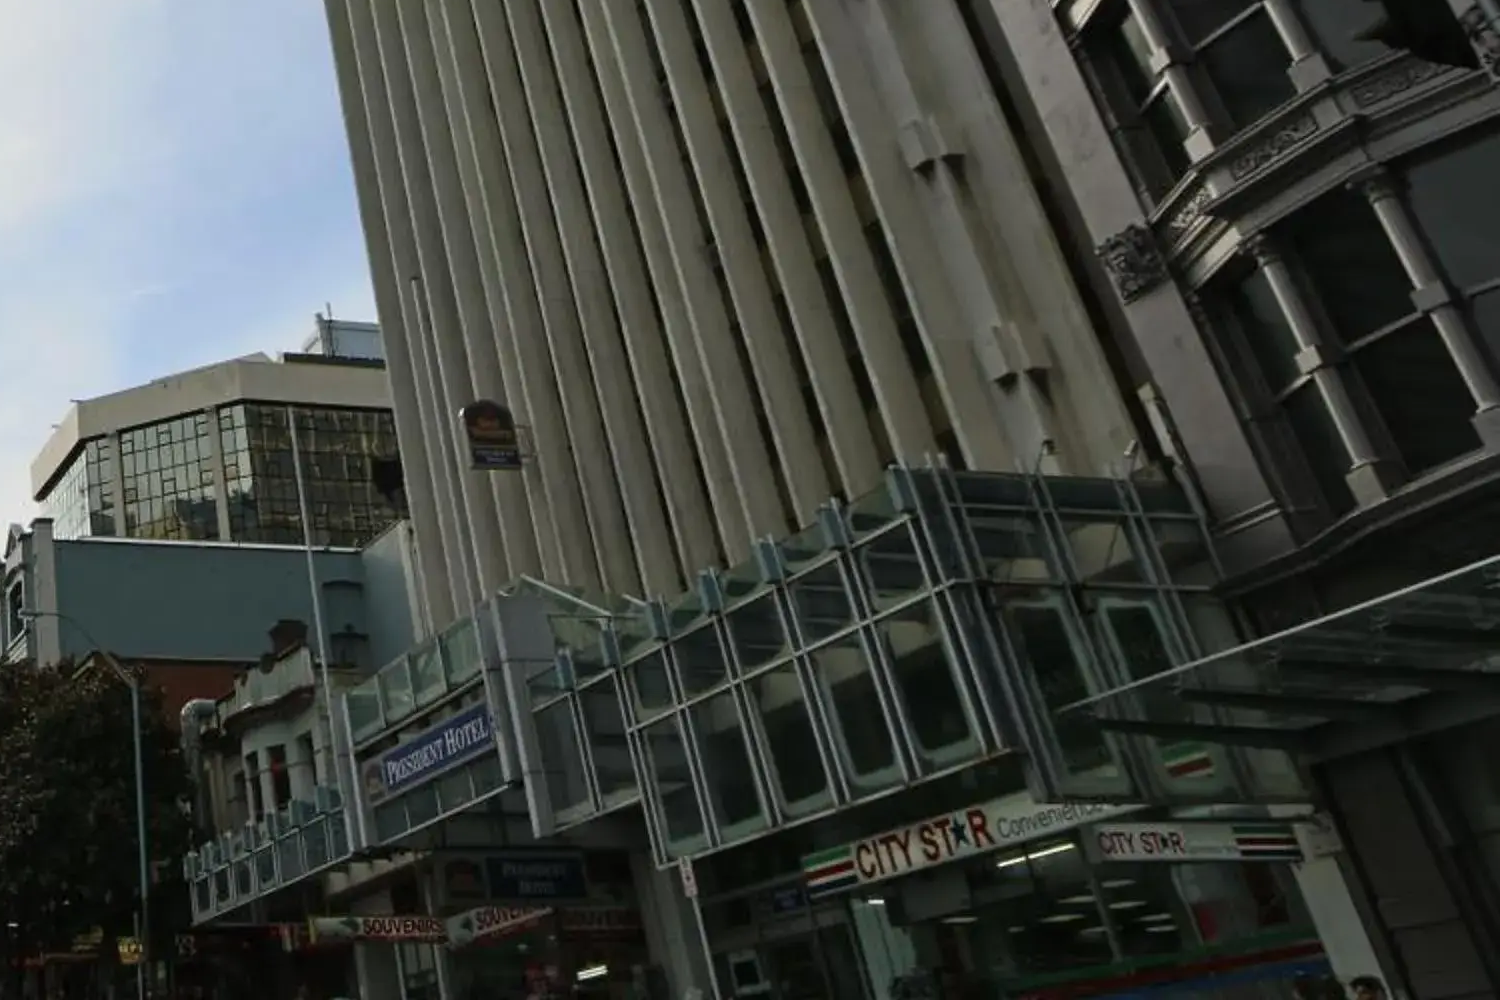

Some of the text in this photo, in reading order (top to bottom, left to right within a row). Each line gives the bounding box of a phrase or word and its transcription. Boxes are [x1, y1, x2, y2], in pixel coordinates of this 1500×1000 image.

[386, 716, 489, 786] PRESIDENT HOTEL
[856, 829, 912, 878] CITY
[1098, 831, 1134, 855] CITY
[363, 918, 444, 935] SOUVENIRS
